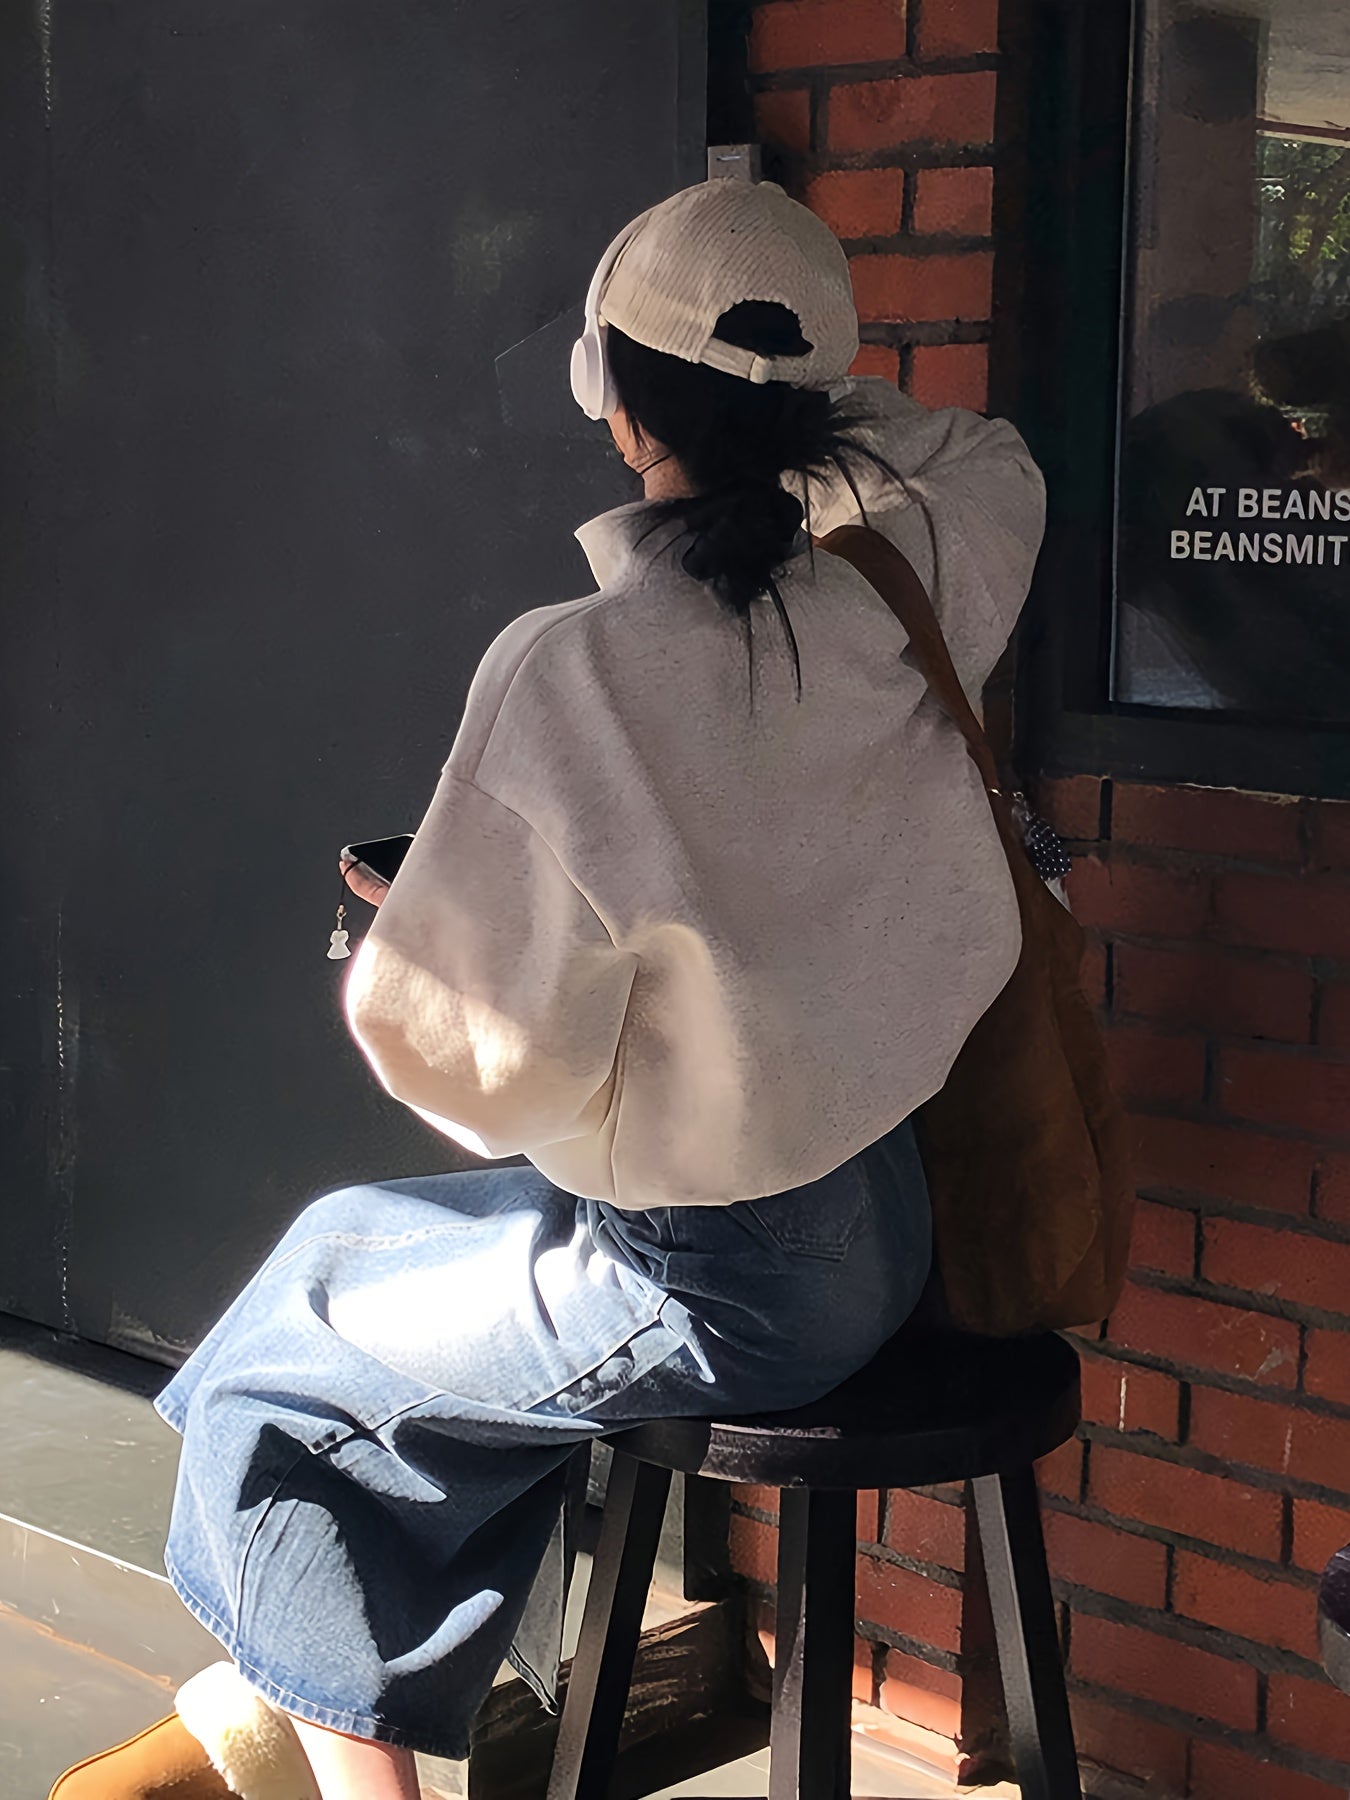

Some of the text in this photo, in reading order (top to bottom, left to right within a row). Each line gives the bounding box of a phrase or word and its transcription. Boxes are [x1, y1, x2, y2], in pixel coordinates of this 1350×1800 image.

[1186, 487, 1350, 521] AT BEANS
[1170, 530, 1349, 566] BEANSMIT
